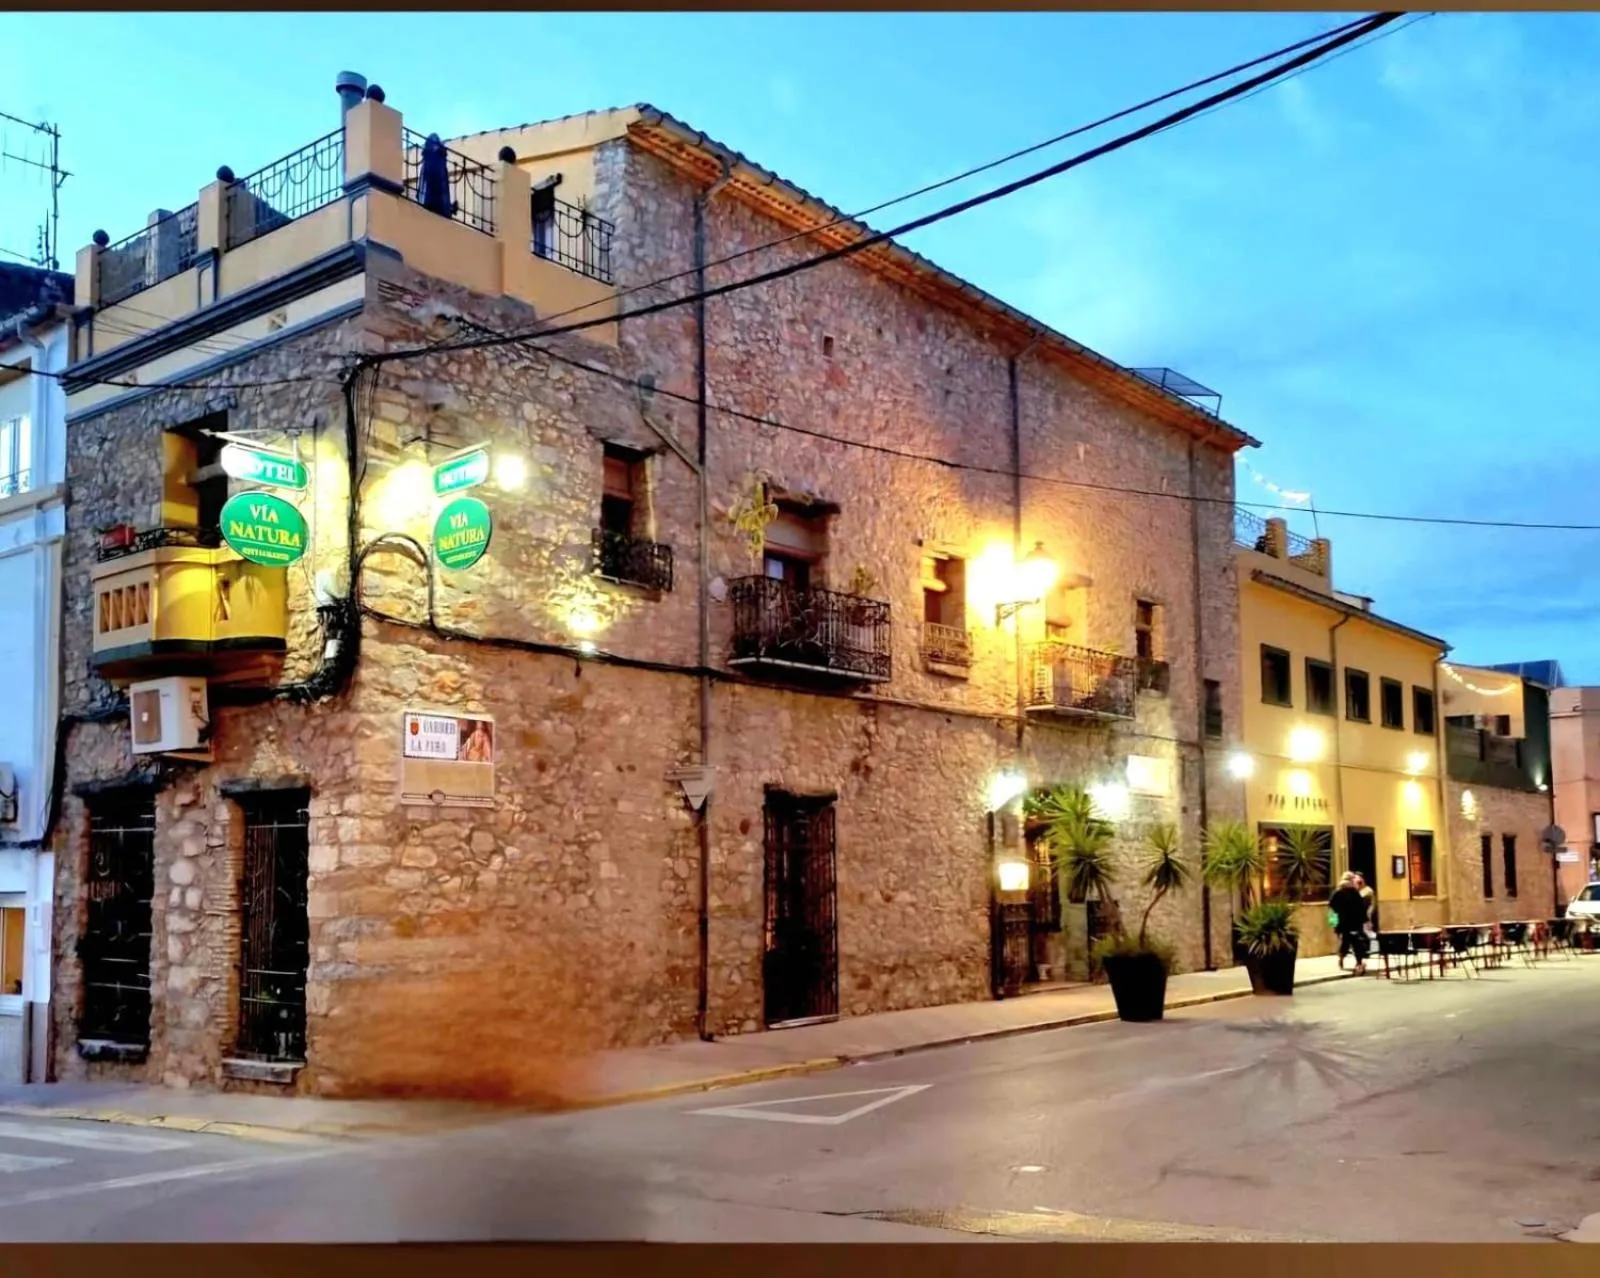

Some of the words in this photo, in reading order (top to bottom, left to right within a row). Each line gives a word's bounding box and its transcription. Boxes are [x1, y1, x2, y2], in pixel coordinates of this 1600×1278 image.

[241, 455, 296, 483] OTEL
[229, 520, 300, 547] NATURA
[440, 525, 484, 550] NATURA
